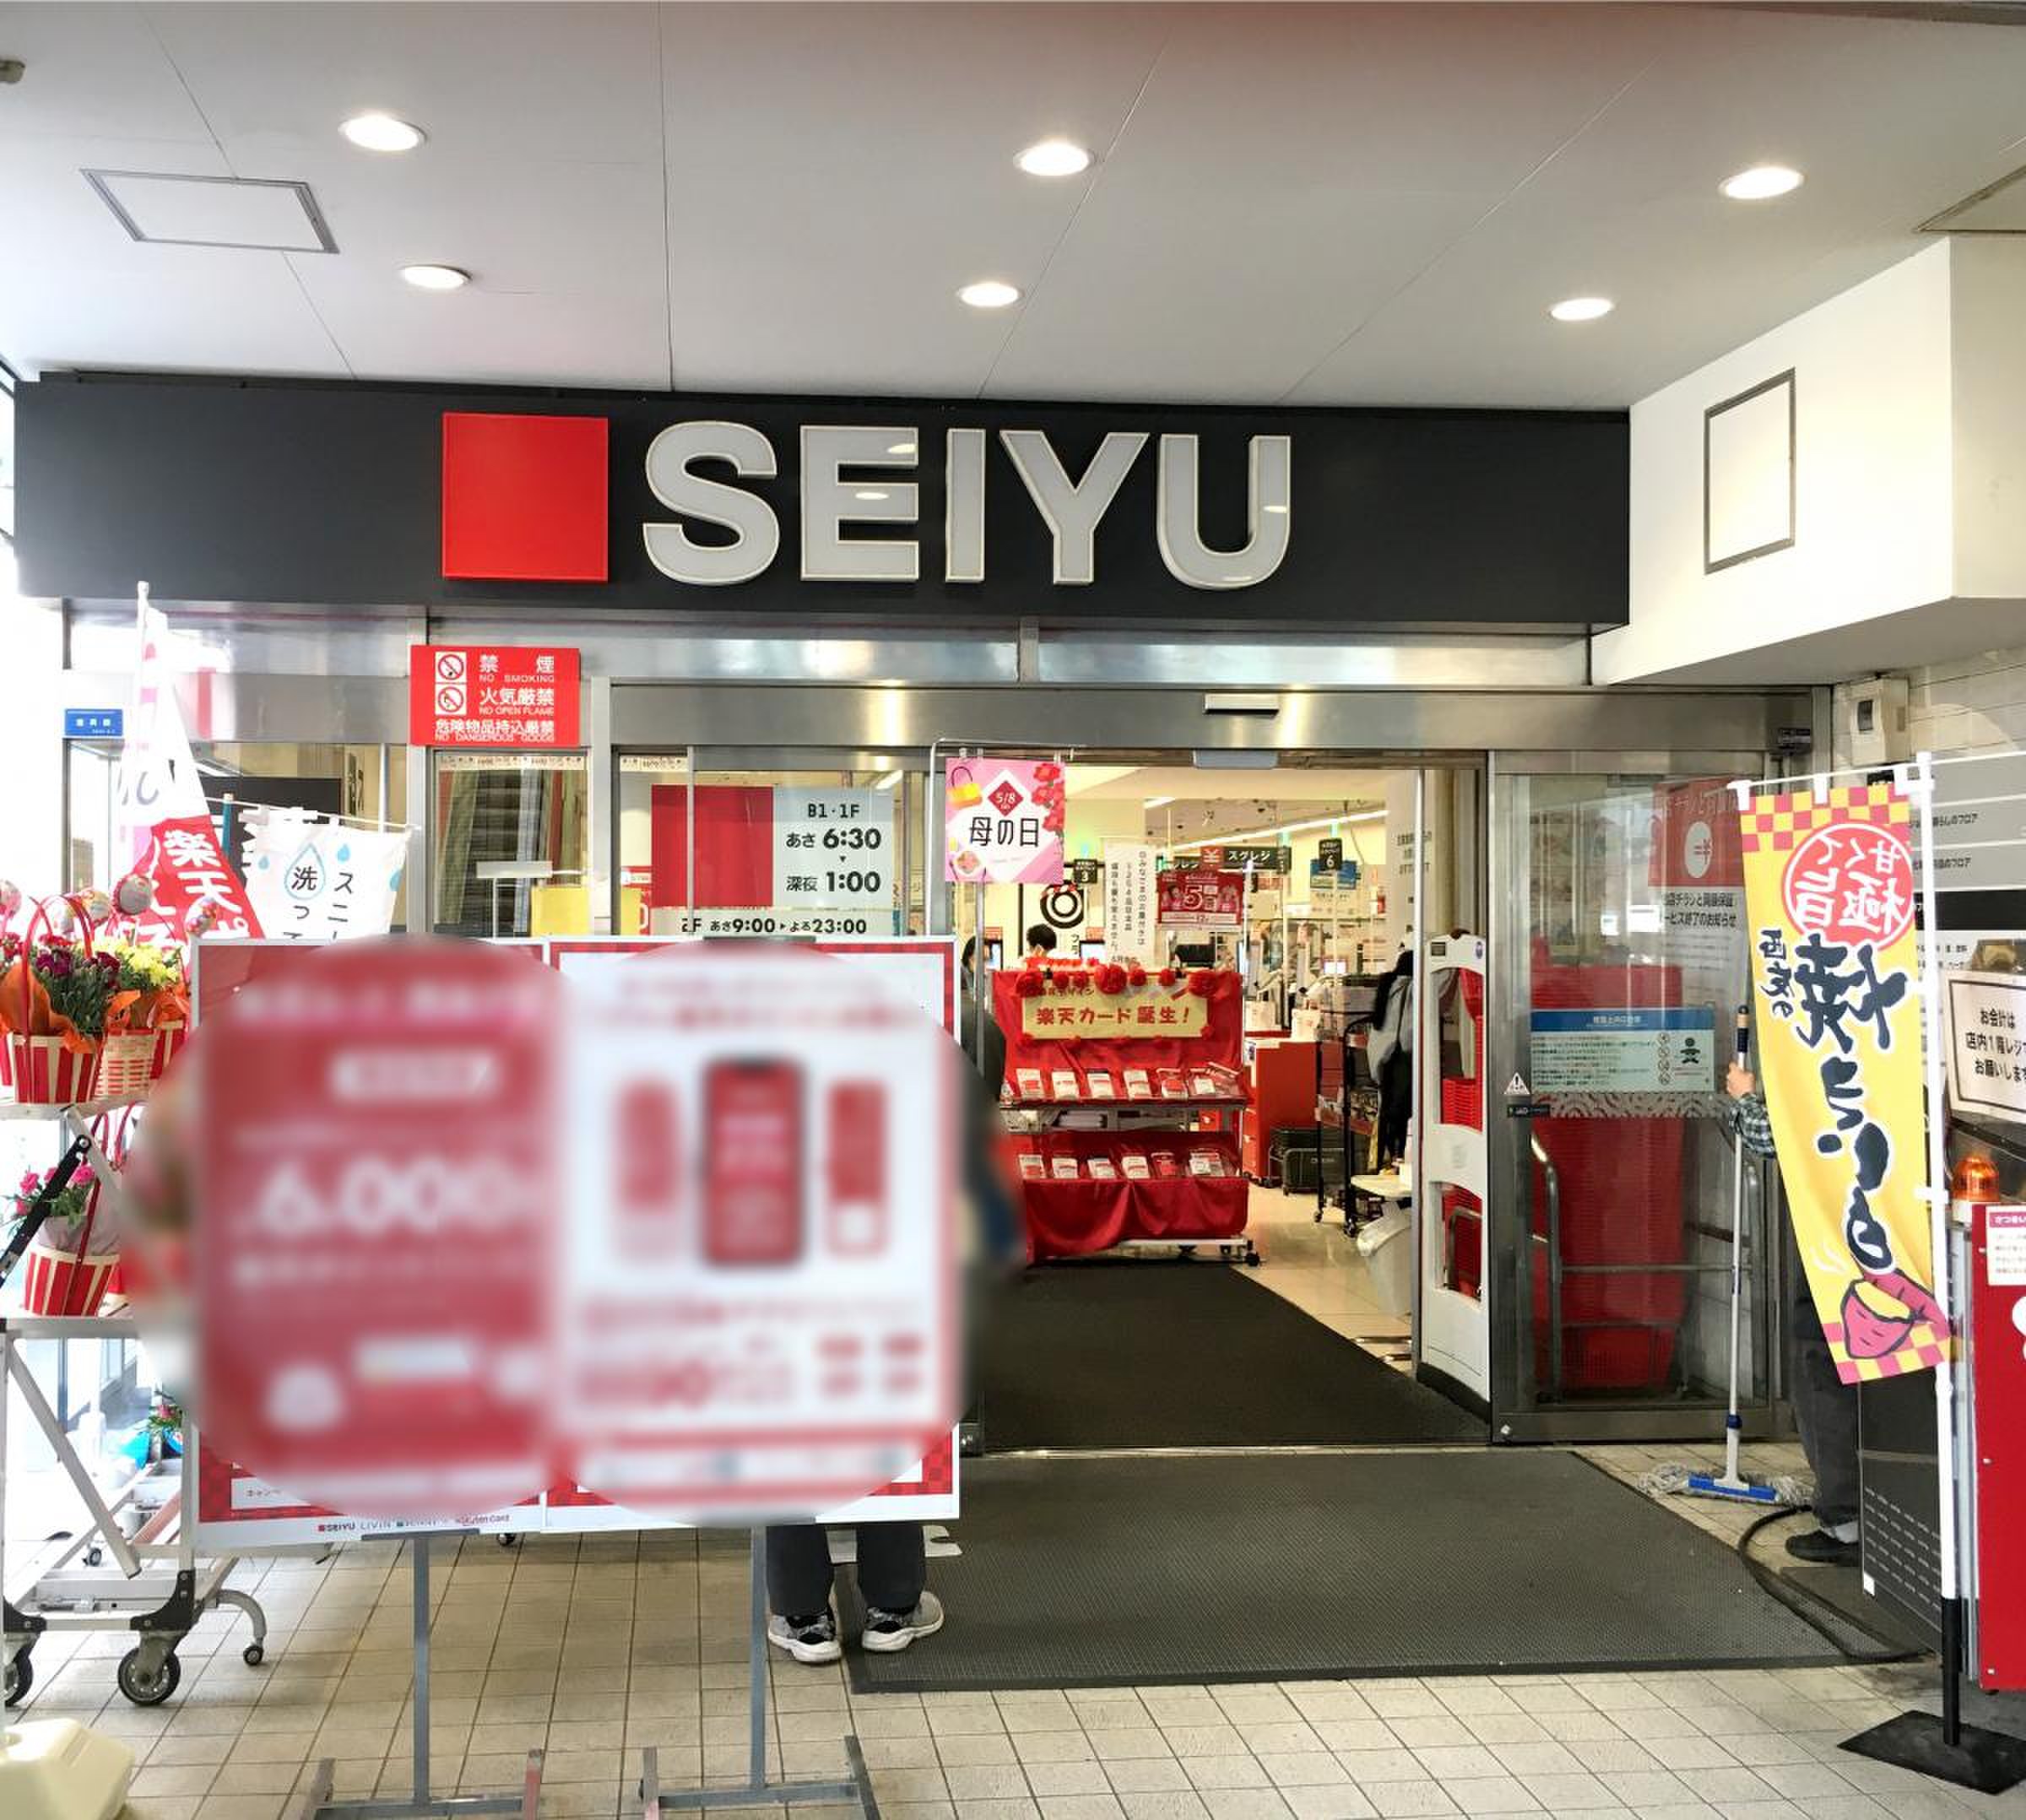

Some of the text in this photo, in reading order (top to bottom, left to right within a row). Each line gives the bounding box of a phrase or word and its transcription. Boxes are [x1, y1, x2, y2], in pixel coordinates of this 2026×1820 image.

[643, 420, 1292, 590] SEIYU
[479, 687, 555, 706] 火気厳禁
[479, 707, 555, 716] NO OPEN FLAME
[995, 792, 1016, 804] 5/8
[786, 827, 881, 849] あさ 6:30
[969, 816, 1039, 848] 母の日
[1326, 855, 1335, 868] 6
[786, 871, 881, 893] 深夜 1:00
[1665, 912, 1736, 928] ービス終了のお知らせ
[1980, 1008, 2015, 1028] お会計は
[325, 1523, 355, 1532] SEIYU
